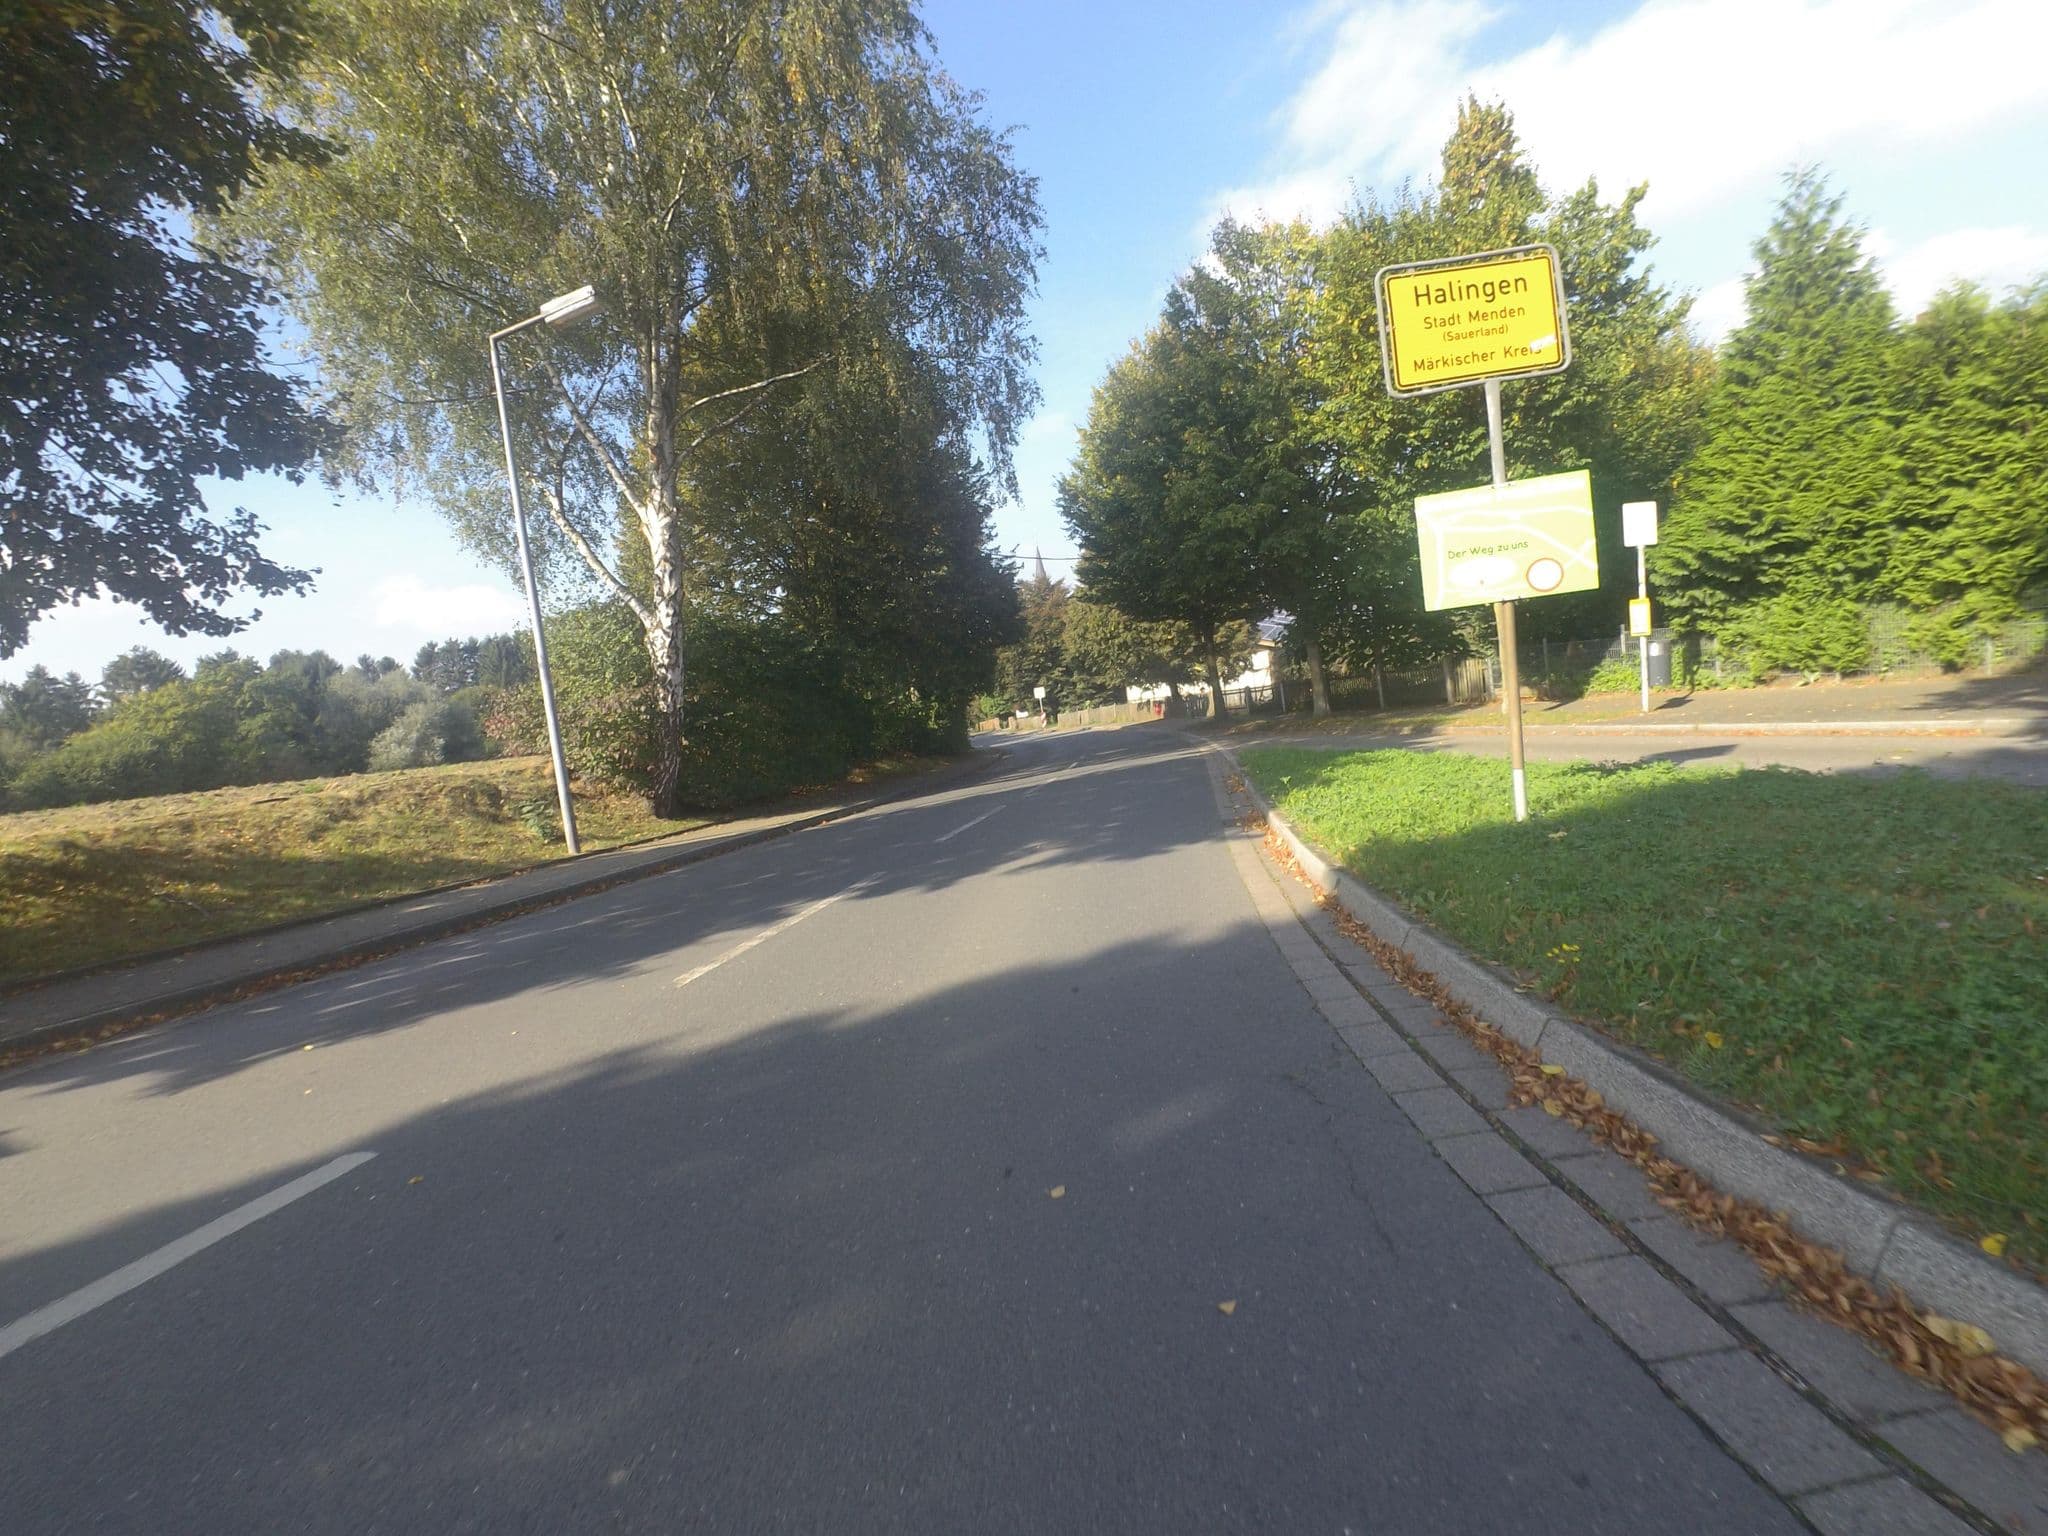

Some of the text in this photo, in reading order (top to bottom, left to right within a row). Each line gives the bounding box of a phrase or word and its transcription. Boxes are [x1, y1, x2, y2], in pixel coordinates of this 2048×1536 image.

[1414, 277, 1528, 307] Halingen
[1423, 306, 1526, 329] Stadt Menden
[1442, 325, 1509, 342] (Sauerland)
[1413, 349, 1495, 372] Märkischer
[1448, 541, 1529, 560] Der Weg zu uns
